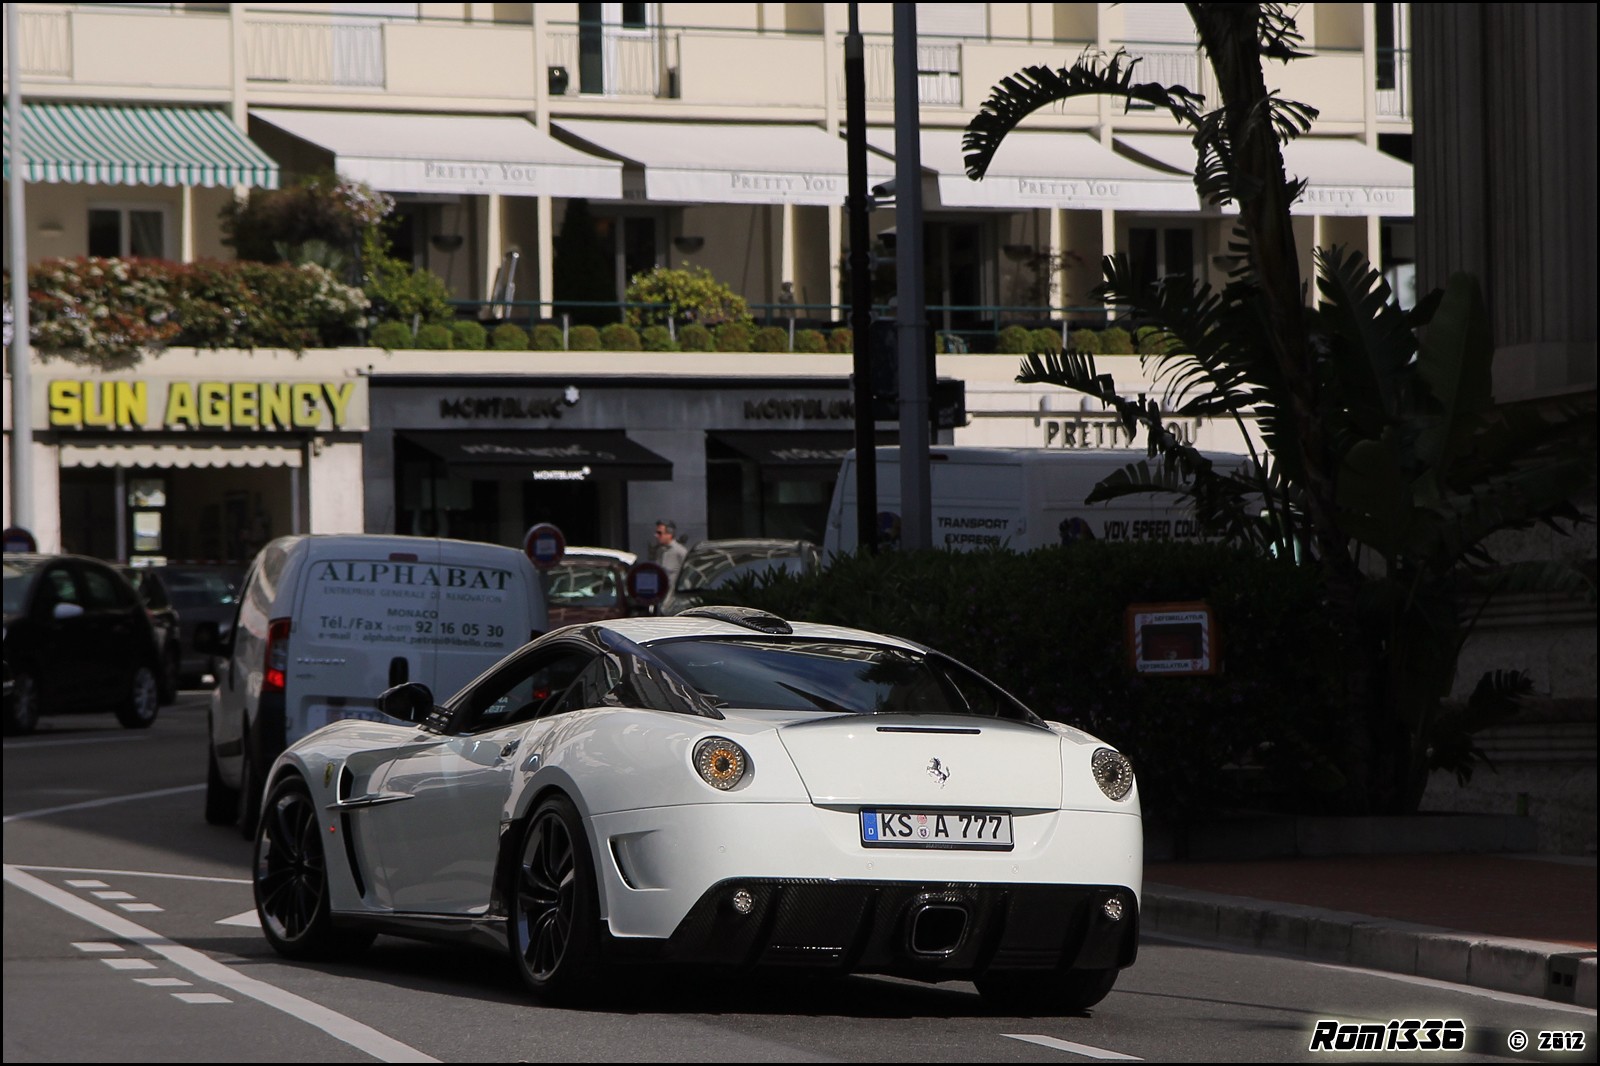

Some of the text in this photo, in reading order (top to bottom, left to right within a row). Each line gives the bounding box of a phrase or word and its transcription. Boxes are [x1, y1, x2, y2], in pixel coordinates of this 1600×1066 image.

[1304, 189, 1355, 203] RETTY
[49, 380, 355, 430] SUN AGENCY
[937, 517, 1009, 530] TRANSPORT
[318, 562, 512, 591] ALPHABAT
[387, 607, 439, 619] MONACO
[415, 620, 433, 634] 92
[440, 621, 455, 635] 16
[462, 622, 479, 637] 05
[486, 624, 504, 638] 30
[882, 813, 913, 838] KS
[935, 814, 949, 838] A
[958, 815, 1003, 839] 777
